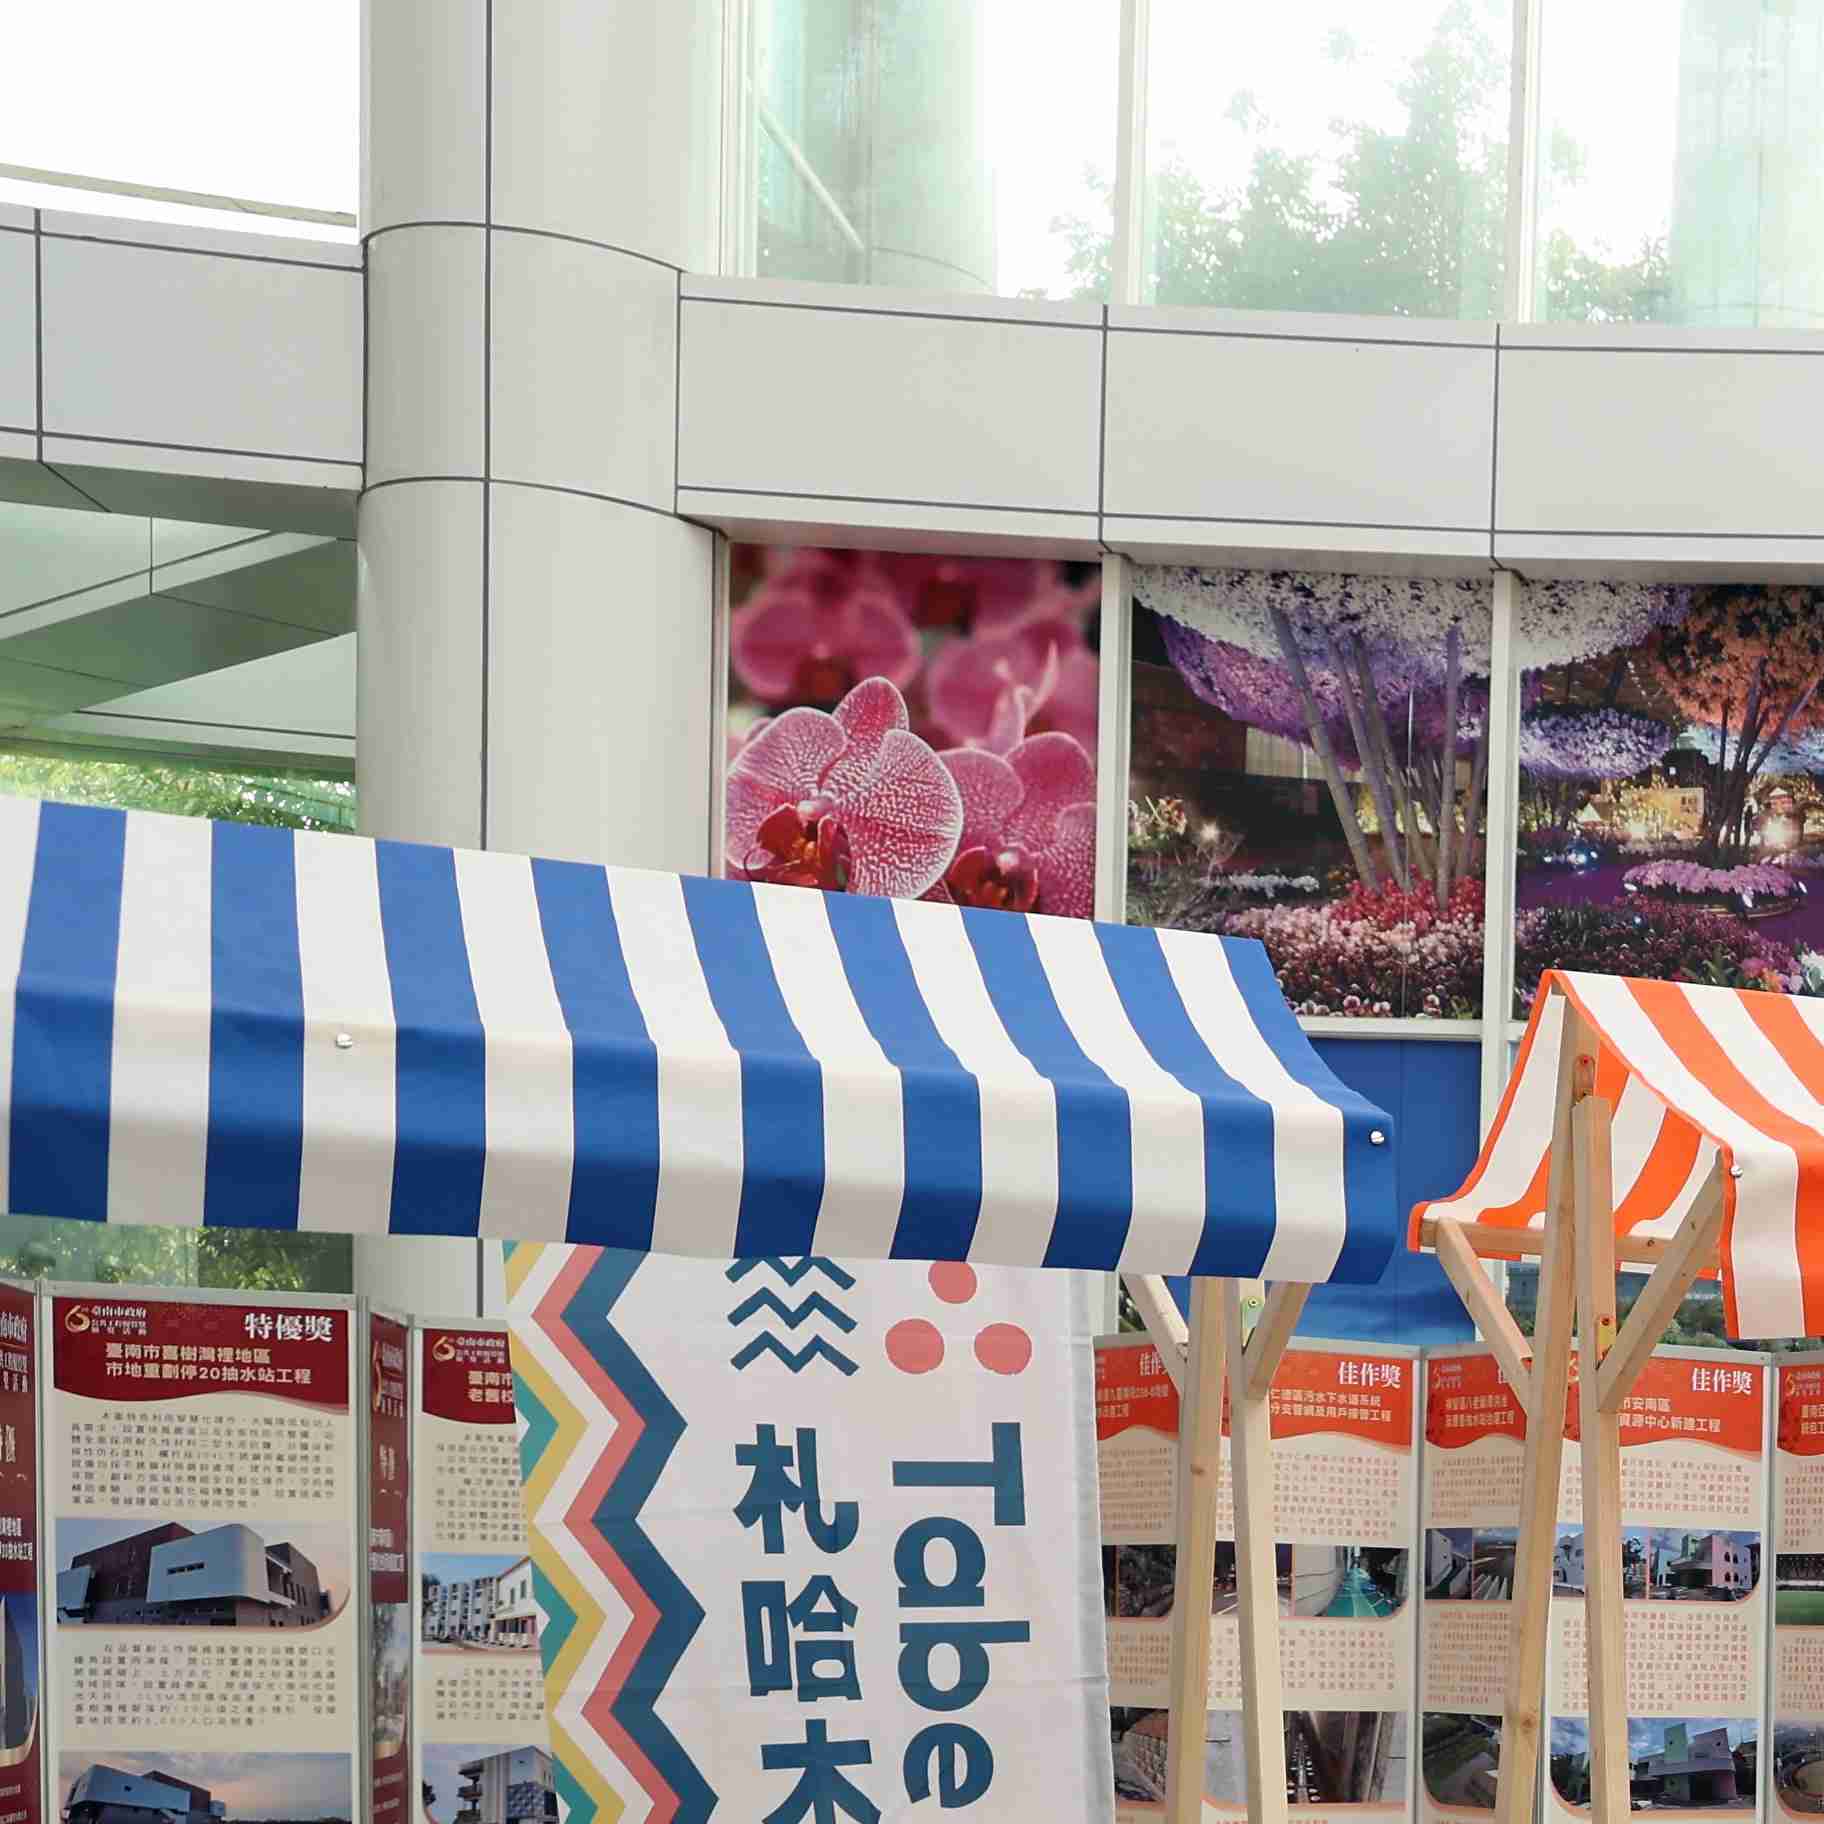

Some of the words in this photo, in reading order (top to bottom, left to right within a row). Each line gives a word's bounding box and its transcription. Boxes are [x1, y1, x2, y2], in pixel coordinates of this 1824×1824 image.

[244, 1312, 334, 1342] 特優獎
[105, 1343, 272, 1364] 臺南市喜樹灣裡地區
[105, 1362, 313, 1385] 市地重劃停20抽水站工程
[1338, 1361, 1402, 1389] 佳作獎
[1691, 1368, 1753, 1395] 佳作獎
[892, 1420, 1030, 1809] Tabe
